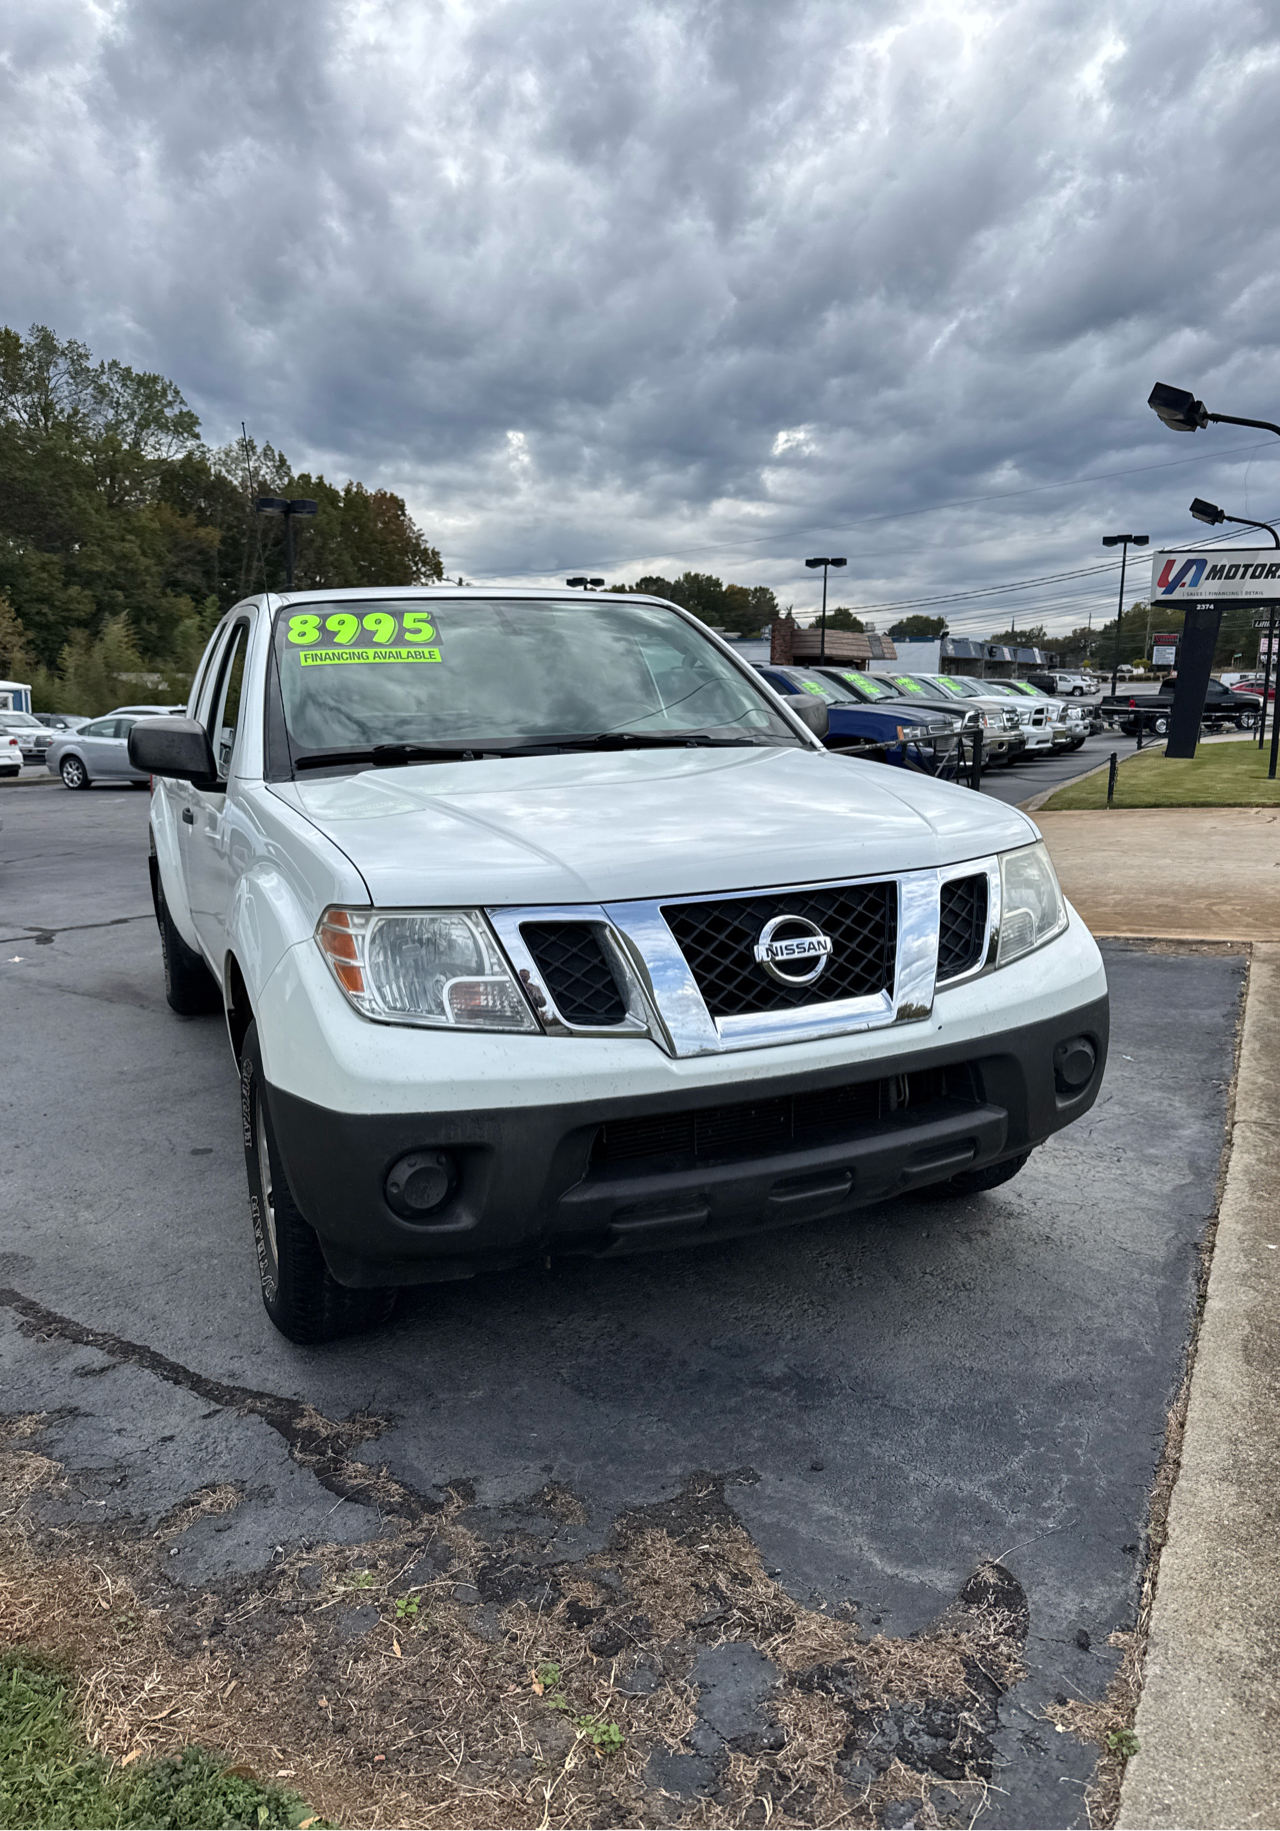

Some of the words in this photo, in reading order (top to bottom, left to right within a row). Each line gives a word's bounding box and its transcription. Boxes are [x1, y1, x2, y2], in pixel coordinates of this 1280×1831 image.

[1204, 563, 1280, 580] MOTOR
[287, 612, 437, 645] 8995
[303, 650, 370, 664] FINANCING
[372, 650, 437, 661] AVAILABLE
[765, 939, 828, 958] NISSAN
